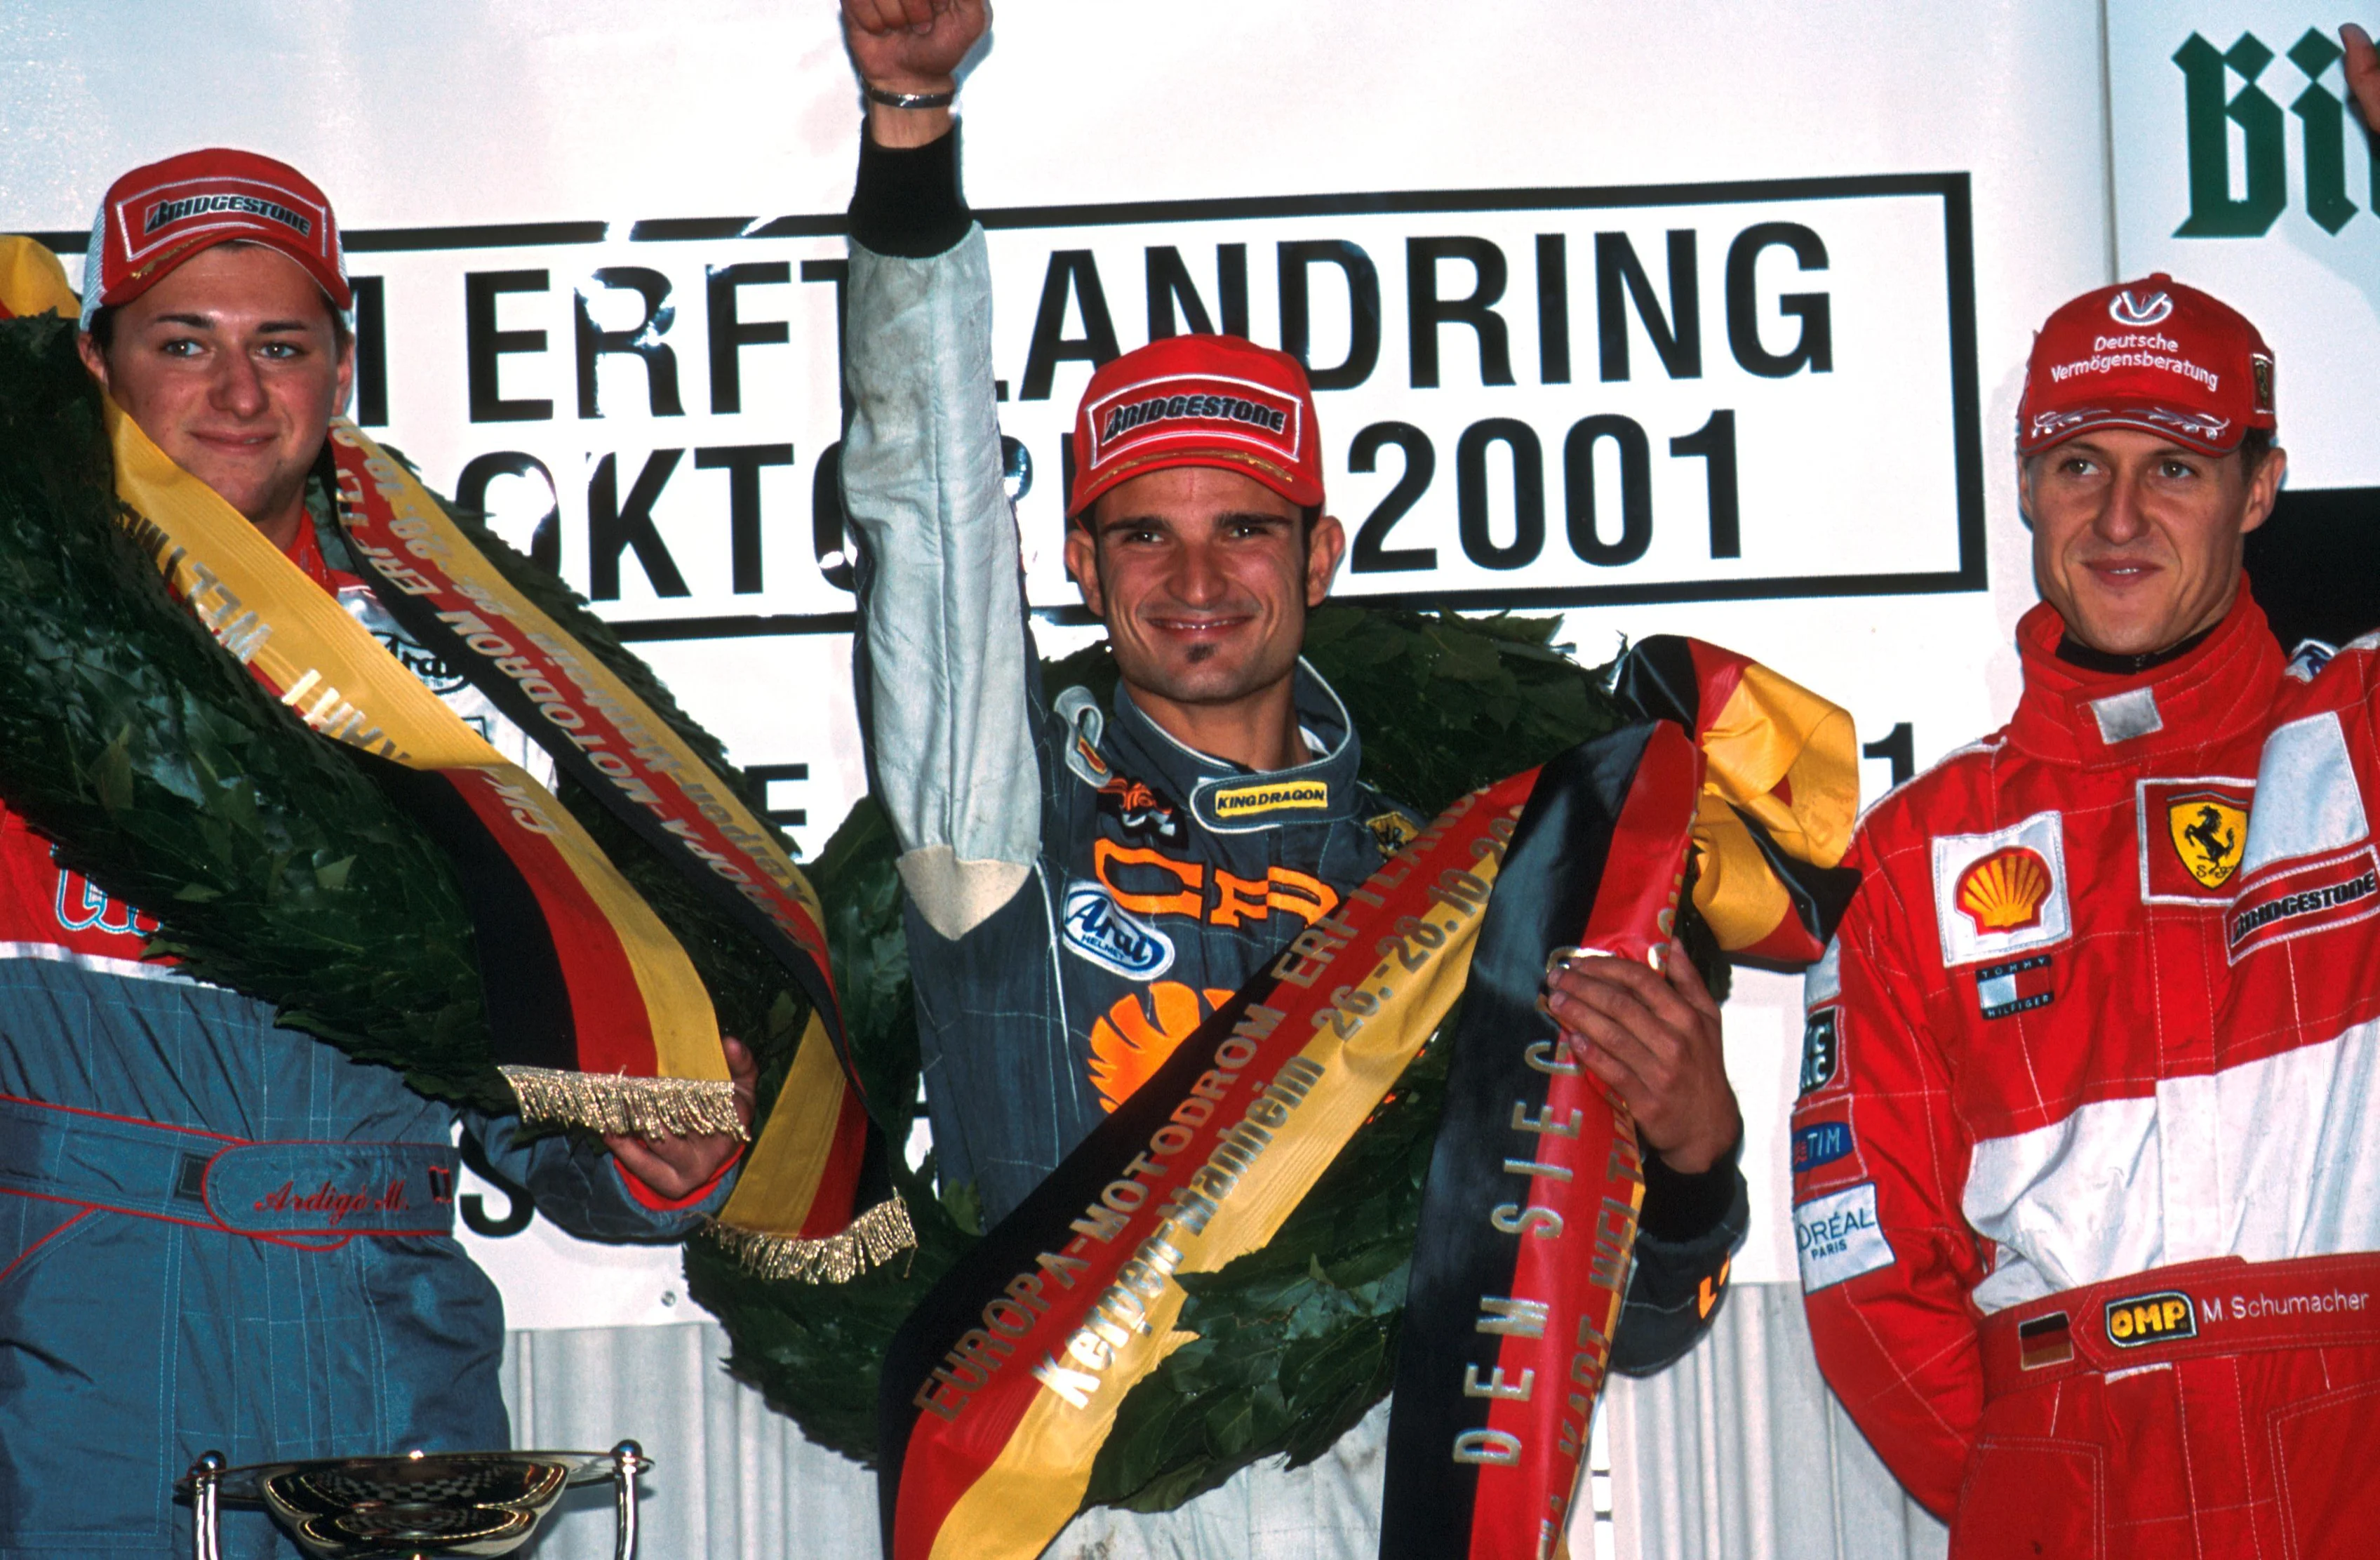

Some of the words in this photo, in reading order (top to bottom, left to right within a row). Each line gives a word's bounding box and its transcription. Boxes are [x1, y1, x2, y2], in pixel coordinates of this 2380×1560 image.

[145, 195, 311, 237] BRIDGESTONE
[2094, 333, 2179, 352] Deutsche
[2051, 351, 2219, 392] Vermögensberatung
[1102, 394, 1286, 446] BRIDGESTONE
[1347, 408, 1741, 575] 2001
[2231, 868, 2378, 947] BRIDGESTONE
[1065, 897, 1149, 962] Arai
[1982, 956, 2045, 978] TOMMY
[1987, 994, 2049, 1018] HILFIGER
[1807, 1126, 1842, 1159] TIM
[914, 1002, 1287, 1423] EUROPA-MOTODROM
[1029, 1053, 1326, 1413] Kerpen-Manheim
[1811, 1238, 1847, 1260] PARIS
[2111, 1298, 2186, 1338] OMP
[2231, 1288, 2369, 1319] Schumacher
[1452, 1293, 1550, 1467] DEM
